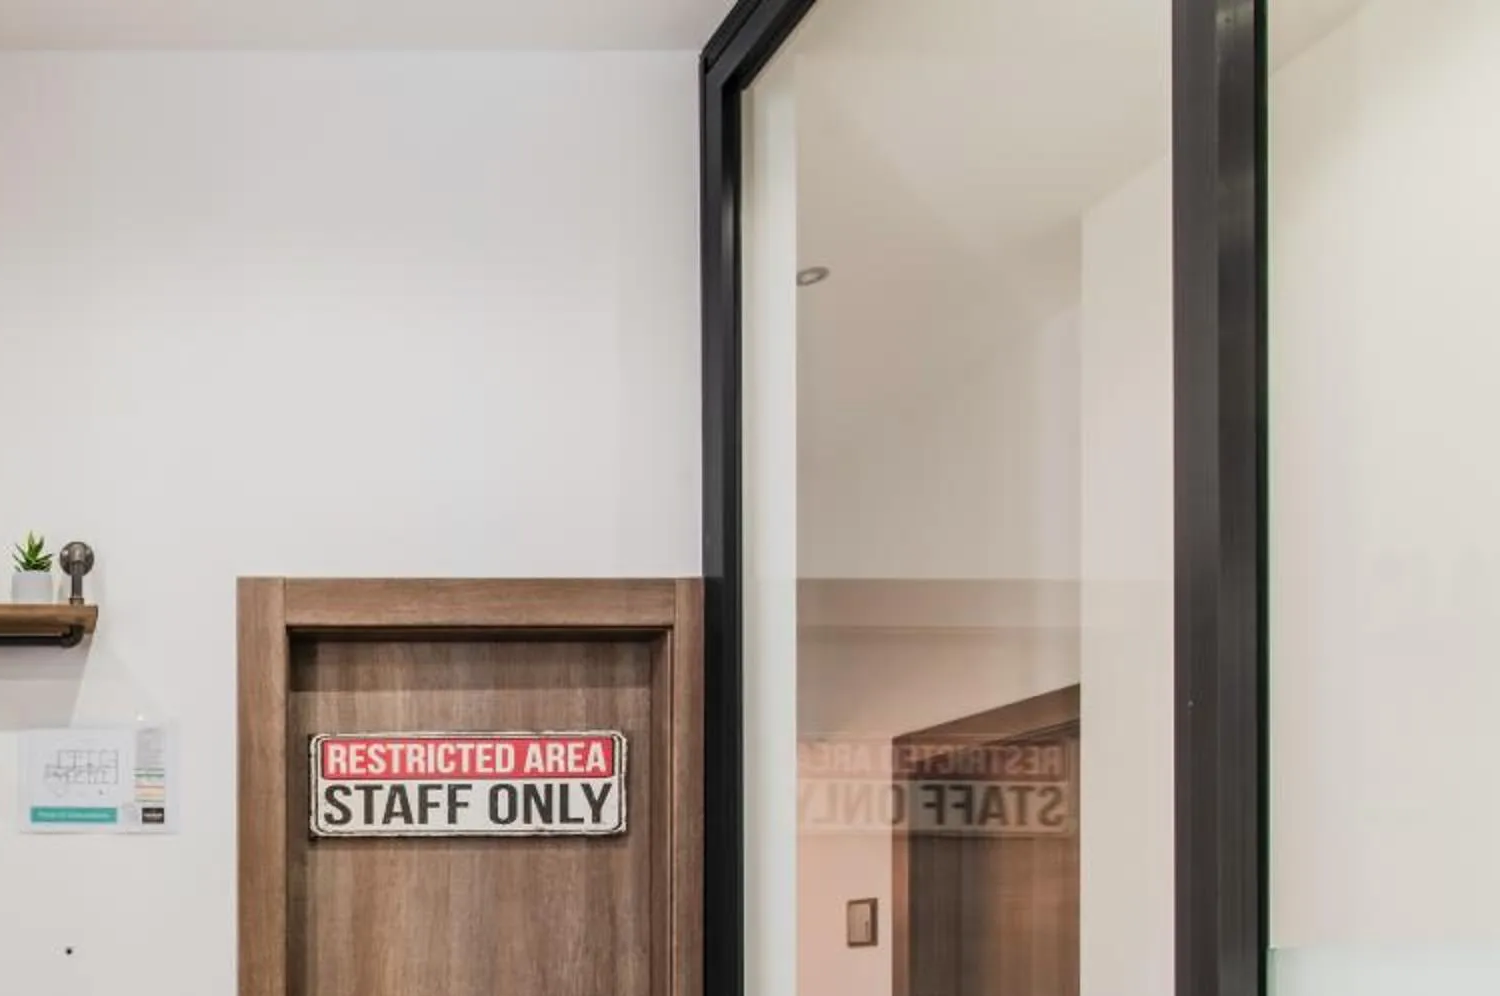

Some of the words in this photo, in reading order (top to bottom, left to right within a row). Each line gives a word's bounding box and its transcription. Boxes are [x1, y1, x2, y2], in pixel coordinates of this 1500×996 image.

[328, 744, 514, 774] RESTRICTED
[524, 743, 606, 773] AREA
[324, 784, 472, 825] STAFF
[488, 784, 612, 825] ONLY
